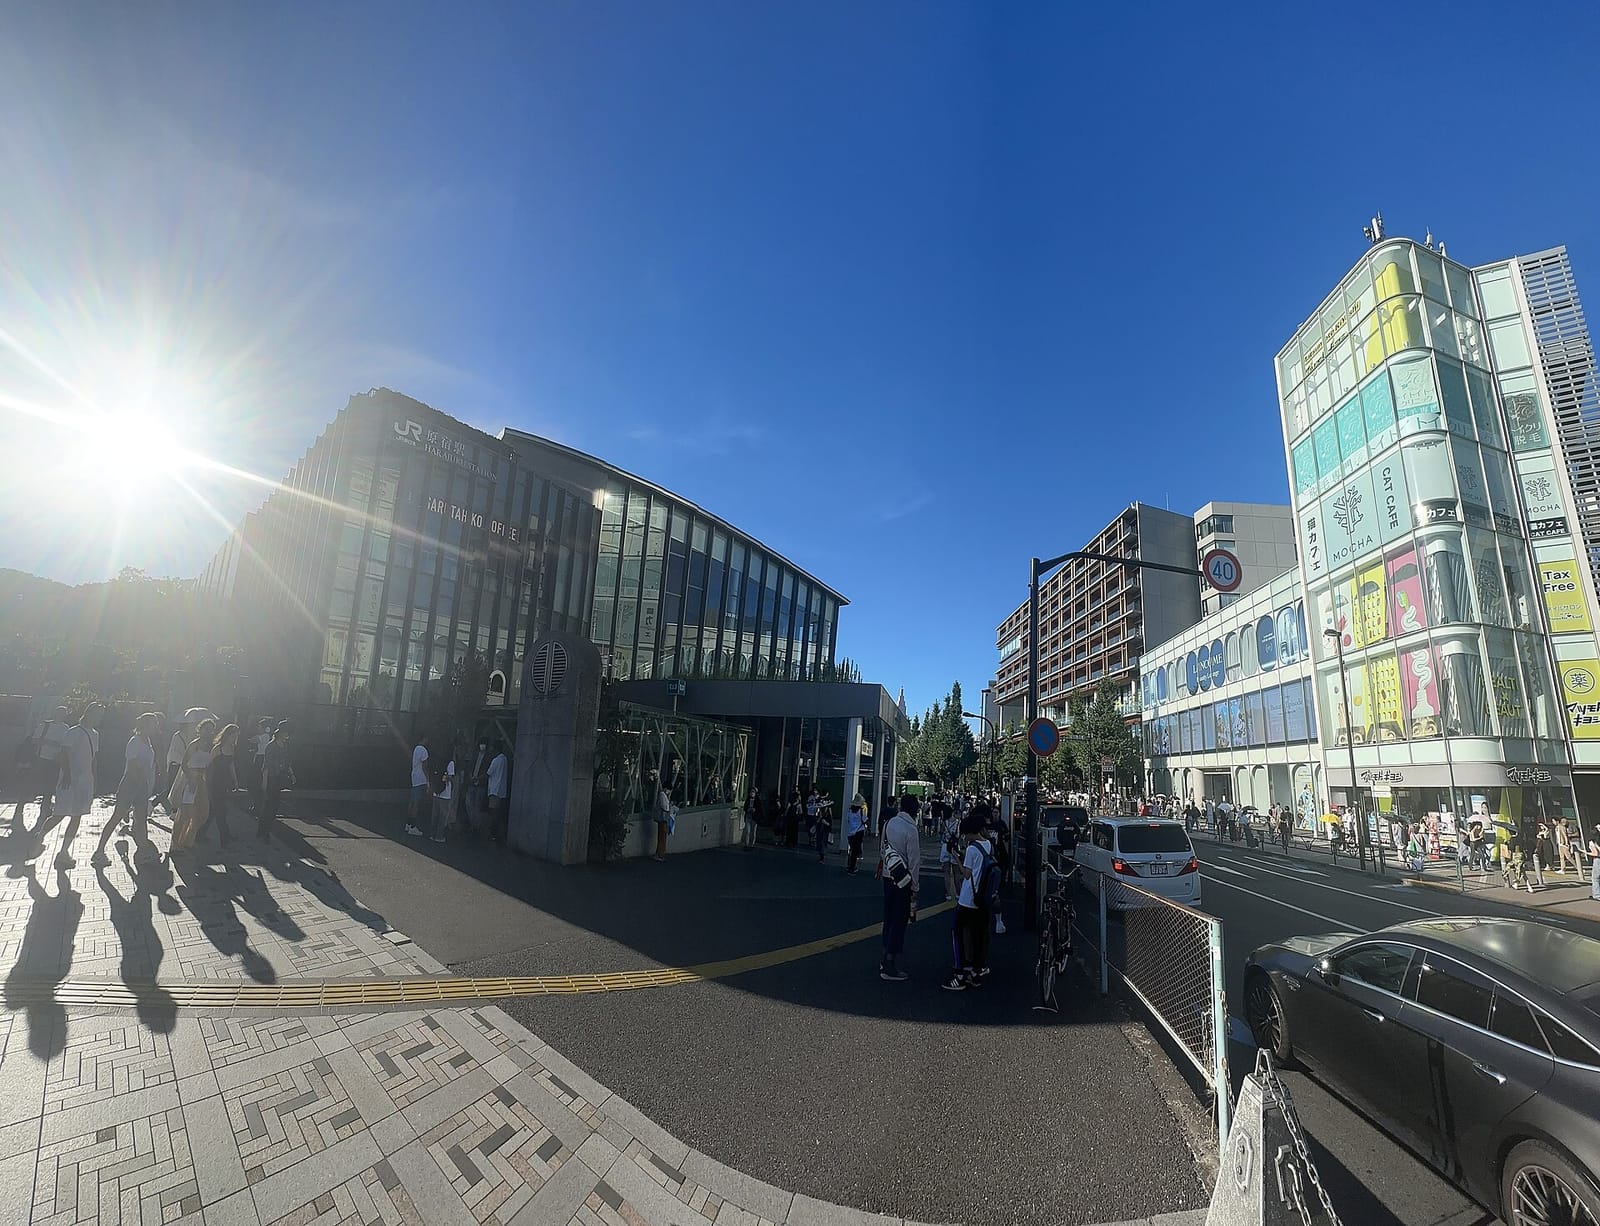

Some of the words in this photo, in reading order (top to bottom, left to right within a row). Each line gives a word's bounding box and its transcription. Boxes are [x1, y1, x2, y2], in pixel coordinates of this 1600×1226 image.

[394, 420, 422, 441] JR
[1382, 467, 1393, 492] CAT
[1386, 495, 1399, 530] CAFE
[1427, 508, 1456, 518] カフェ
[1546, 528, 1565, 536] CAFE
[1307, 517, 1321, 571] 猫カフェ
[1333, 535, 1373, 562] MOCHA
[1212, 560, 1234, 581] 40
[1542, 570, 1571, 581] Tax
[1542, 582, 1576, 593] Free
